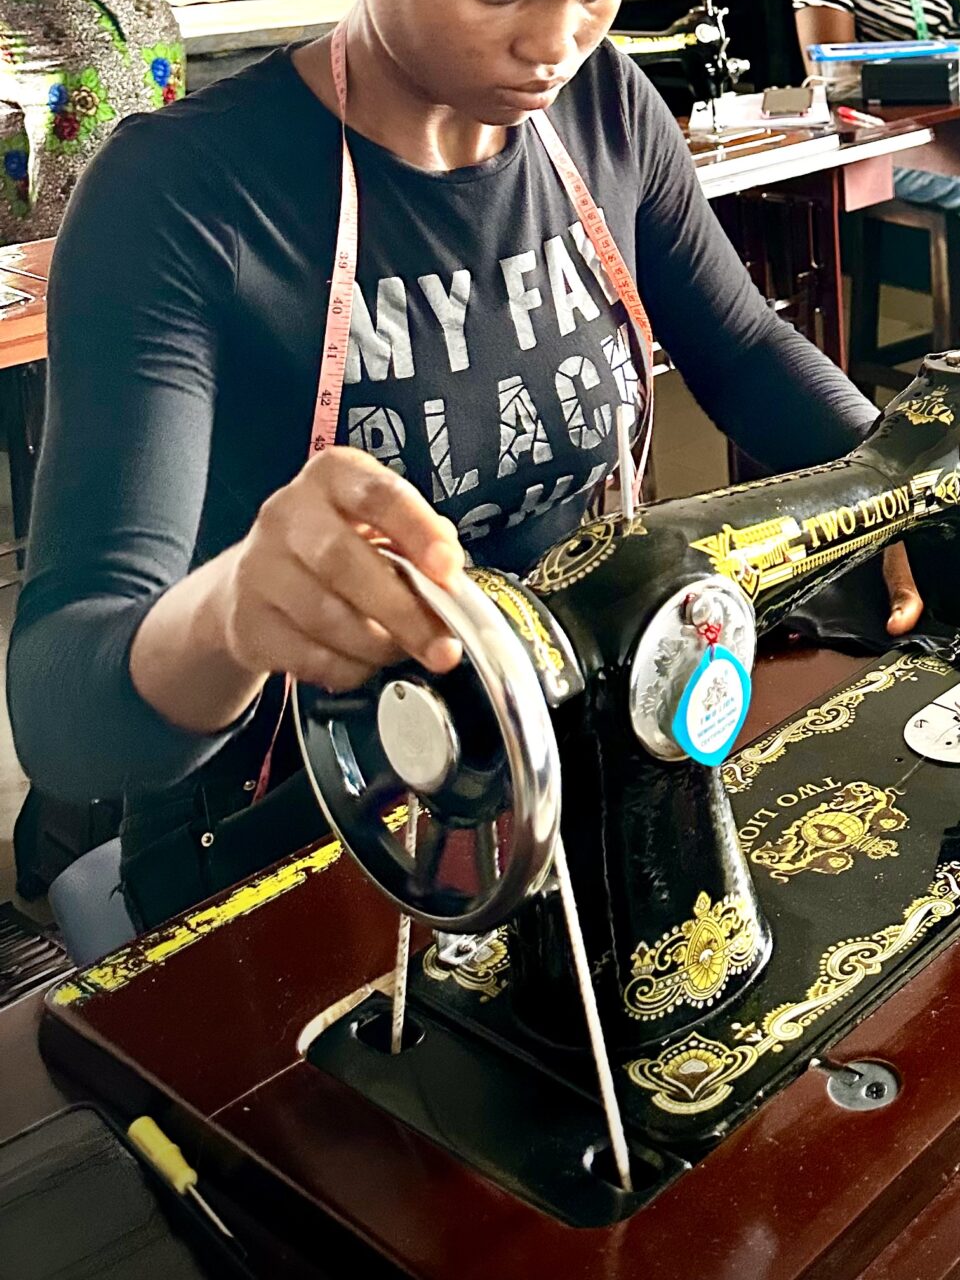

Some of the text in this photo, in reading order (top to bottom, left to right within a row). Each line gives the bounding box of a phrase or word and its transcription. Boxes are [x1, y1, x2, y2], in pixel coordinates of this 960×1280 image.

[344, 269, 471, 384] MY
[802, 485, 910, 548] TWO LION
[777, 777, 841, 807] TWO
